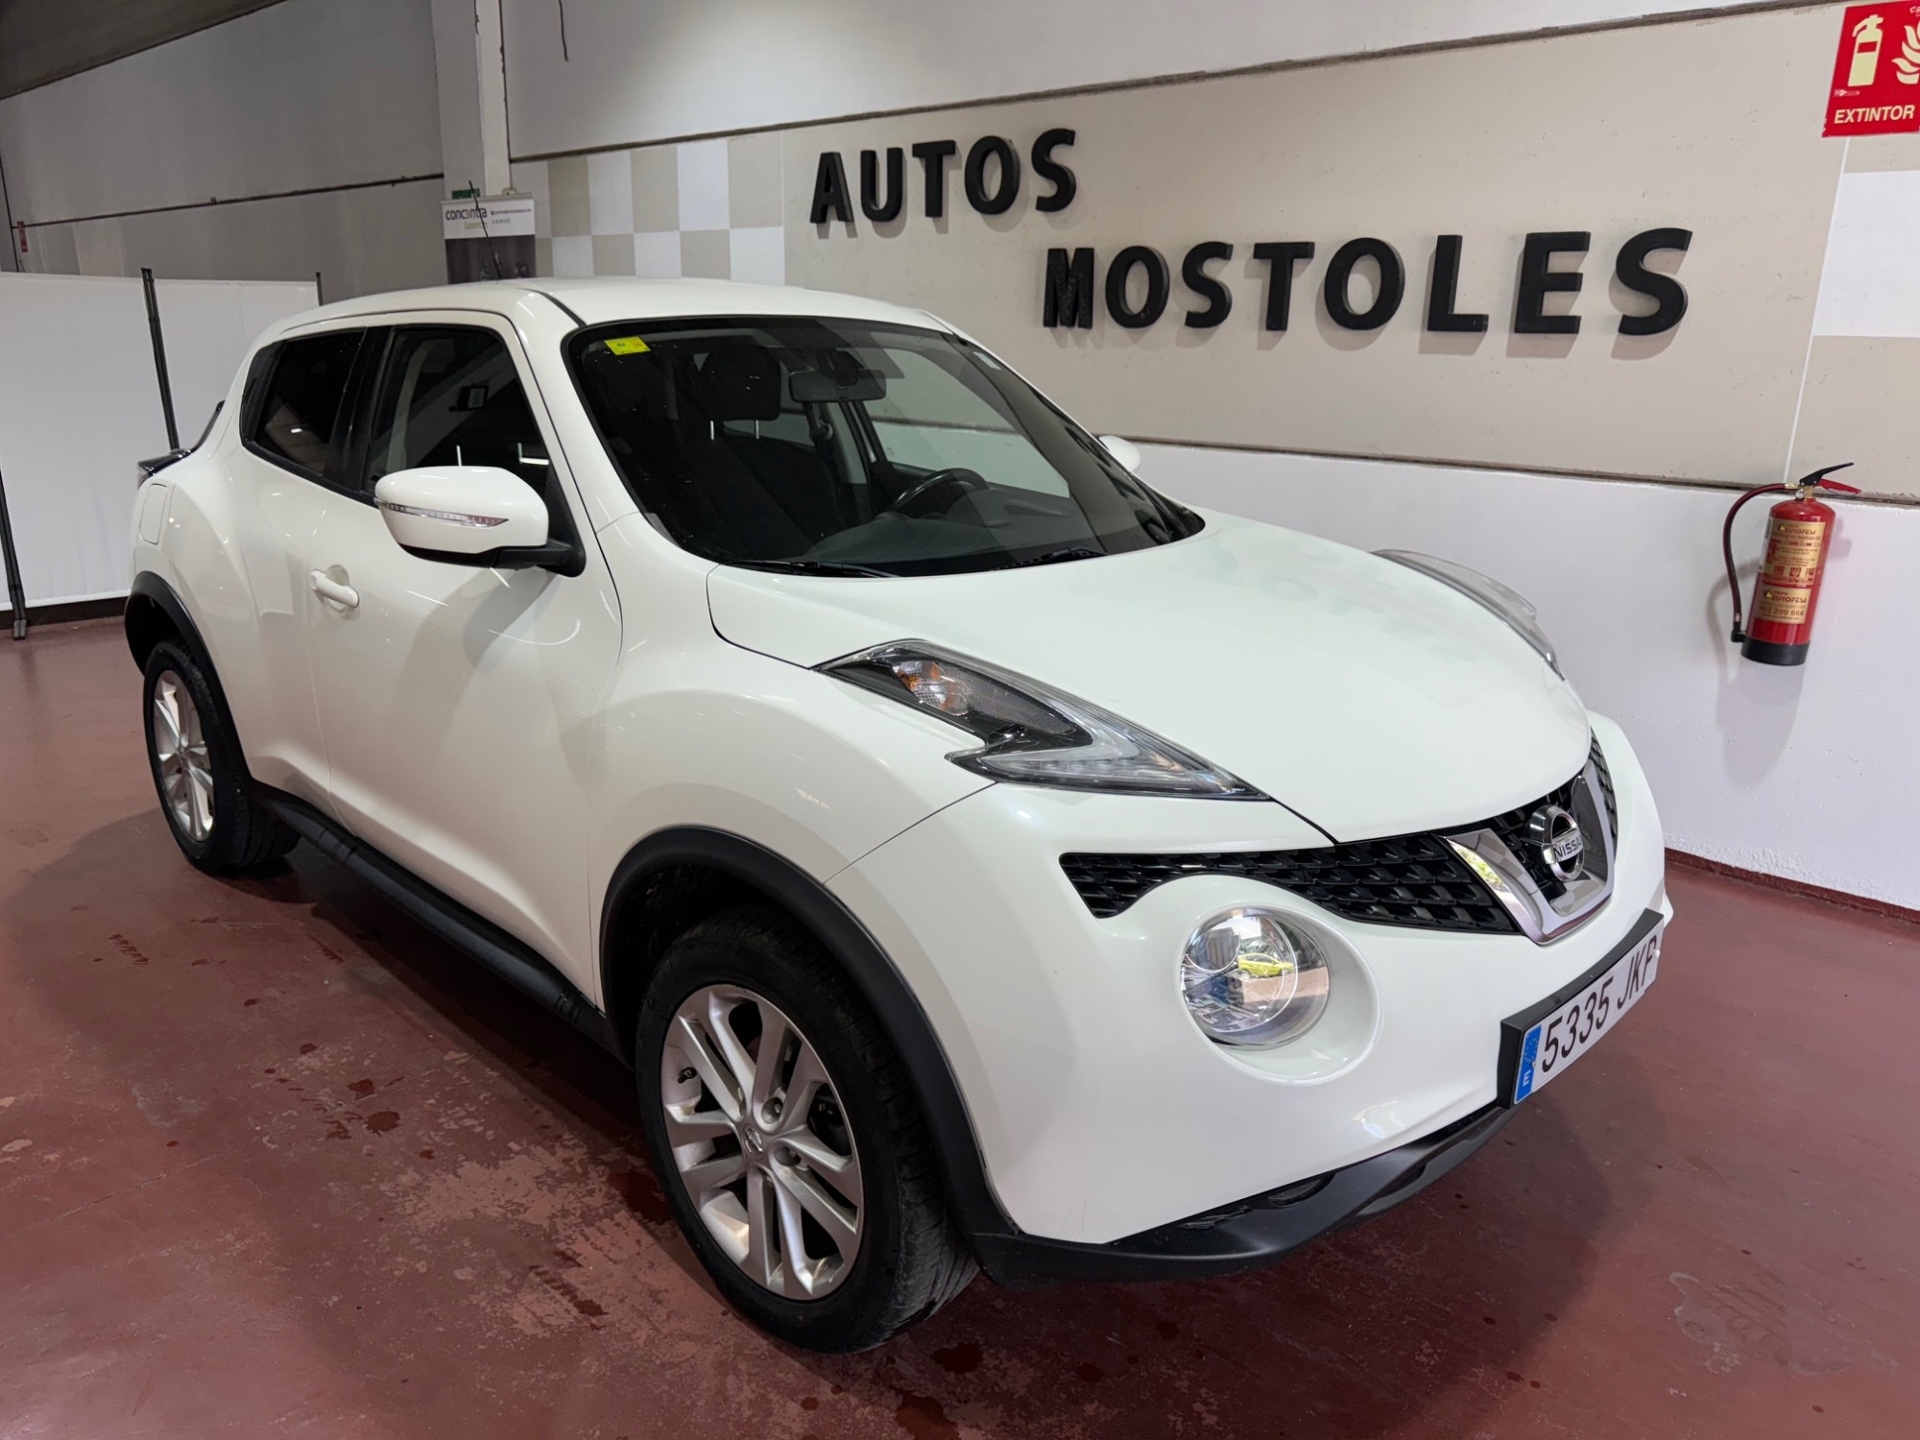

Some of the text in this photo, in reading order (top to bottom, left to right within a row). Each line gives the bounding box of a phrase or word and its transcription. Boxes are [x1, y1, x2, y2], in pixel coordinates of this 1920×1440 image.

[1834, 104, 1916, 124] EXTINTOR
[809, 128, 1077, 224] AUTOS
[1043, 227, 1693, 336] MOSTOLES
[1553, 836, 1583, 858] NISSA
[1542, 976, 1614, 1072] 5335
